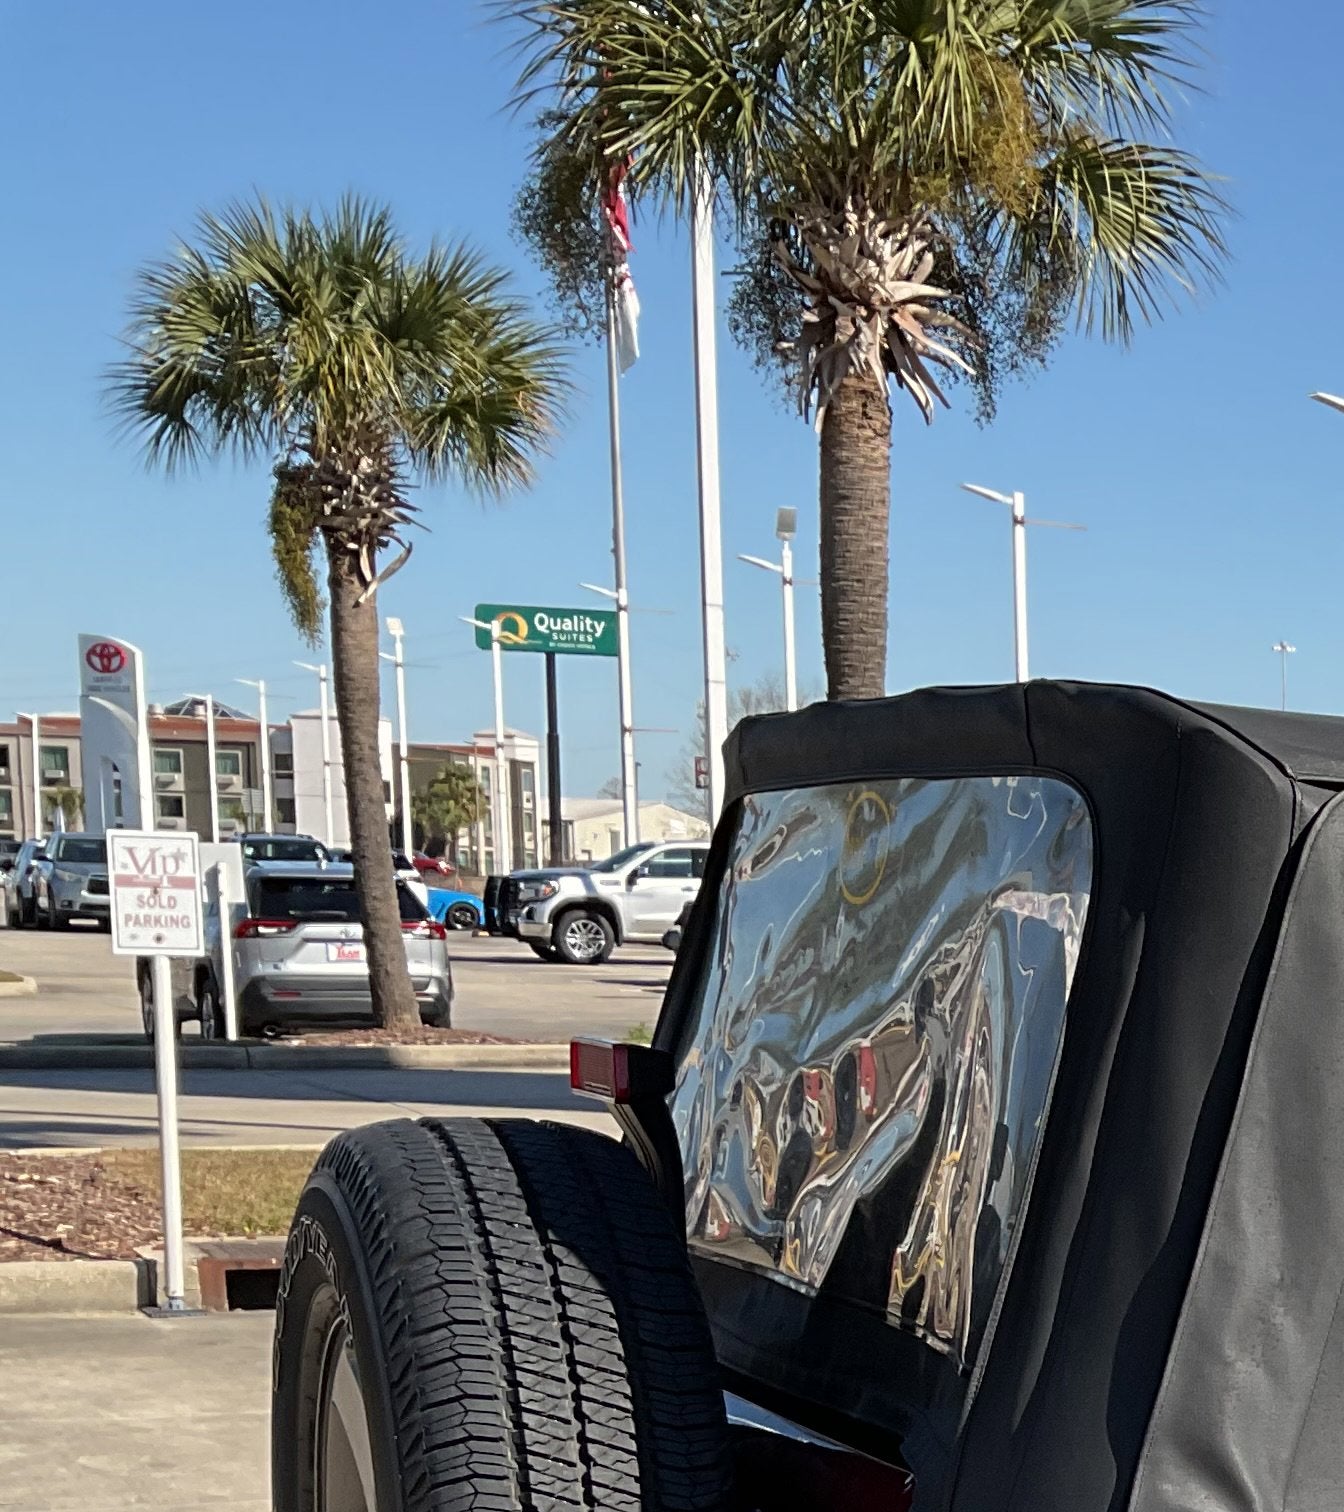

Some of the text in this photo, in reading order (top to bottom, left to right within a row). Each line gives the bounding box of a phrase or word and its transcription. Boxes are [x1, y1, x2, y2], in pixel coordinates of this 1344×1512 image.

[534, 612, 605, 637] Quality
[552, 632, 593, 643] SUITES
[136, 895, 178, 909] SOLD
[124, 914, 191, 929] PARKING
